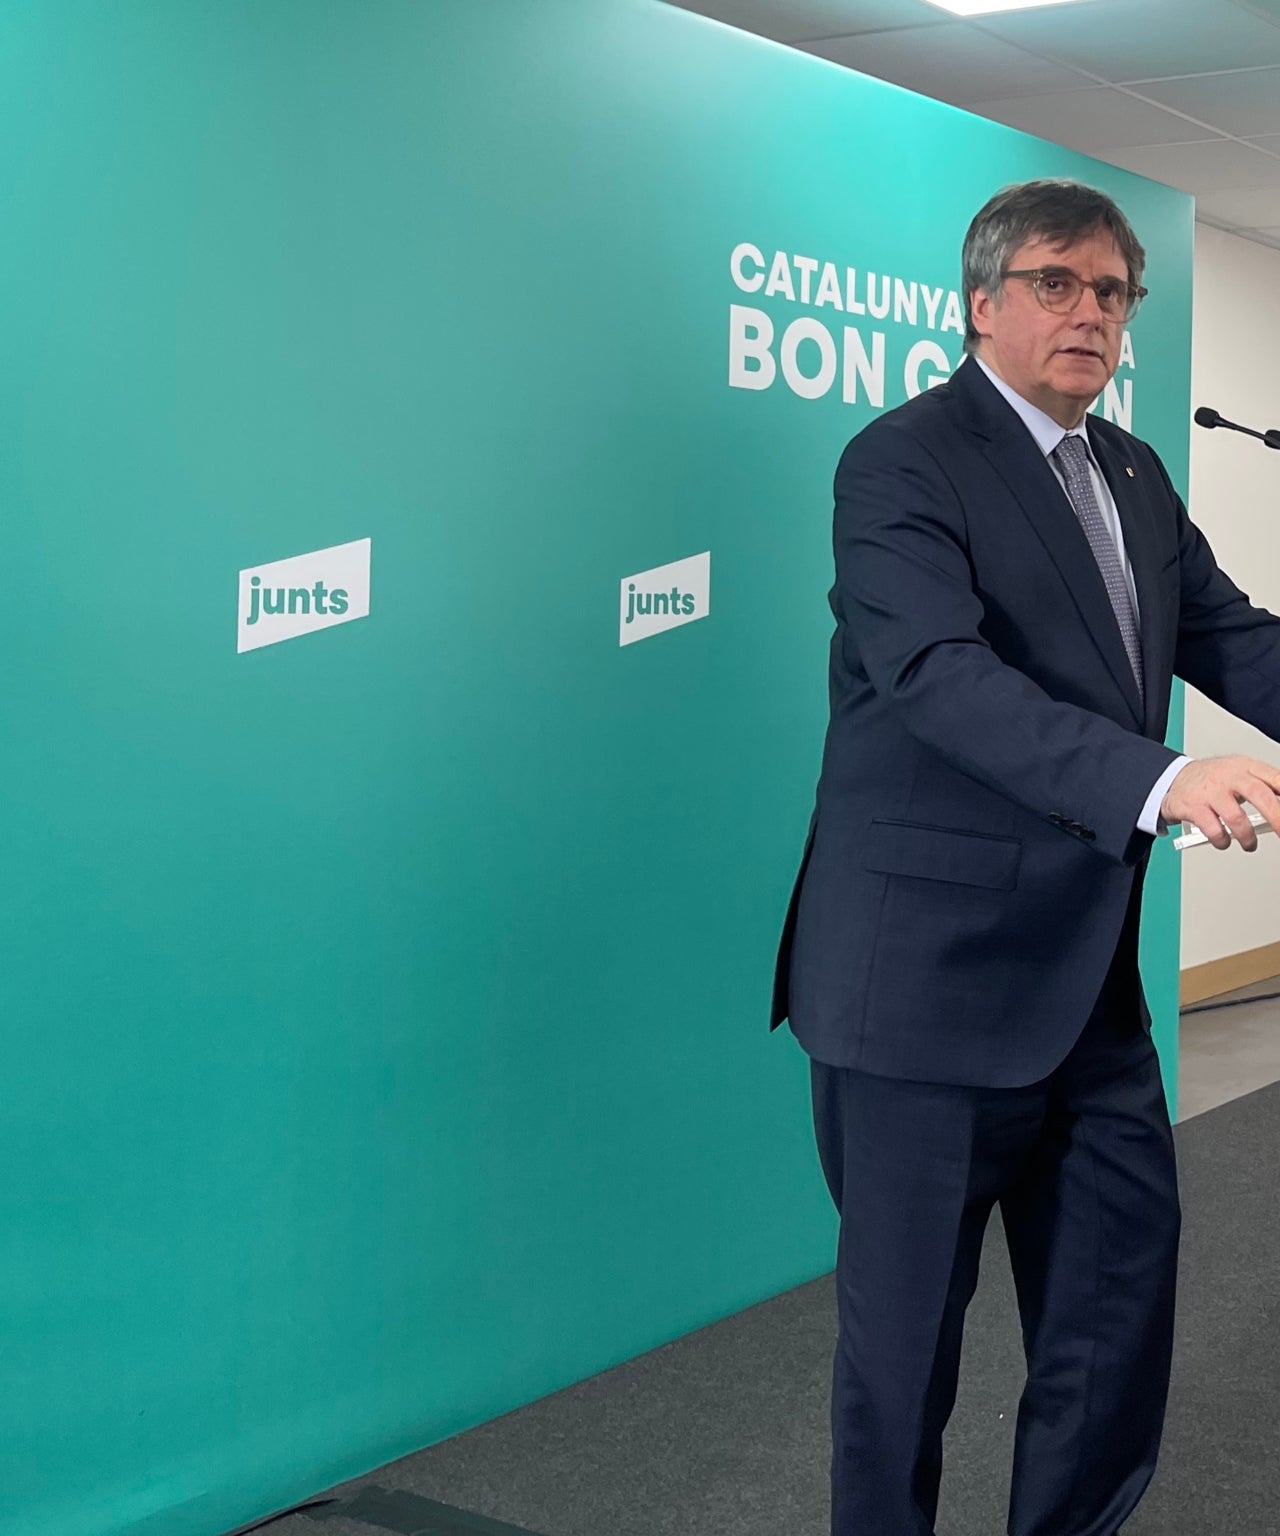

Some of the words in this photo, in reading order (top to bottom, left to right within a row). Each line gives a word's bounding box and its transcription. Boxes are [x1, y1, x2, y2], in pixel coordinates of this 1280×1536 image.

[730, 242, 966, 336] CATALUNYA
[729, 304, 886, 407] BON
[246, 576, 349, 625] junts
[626, 583, 695, 624] junts
